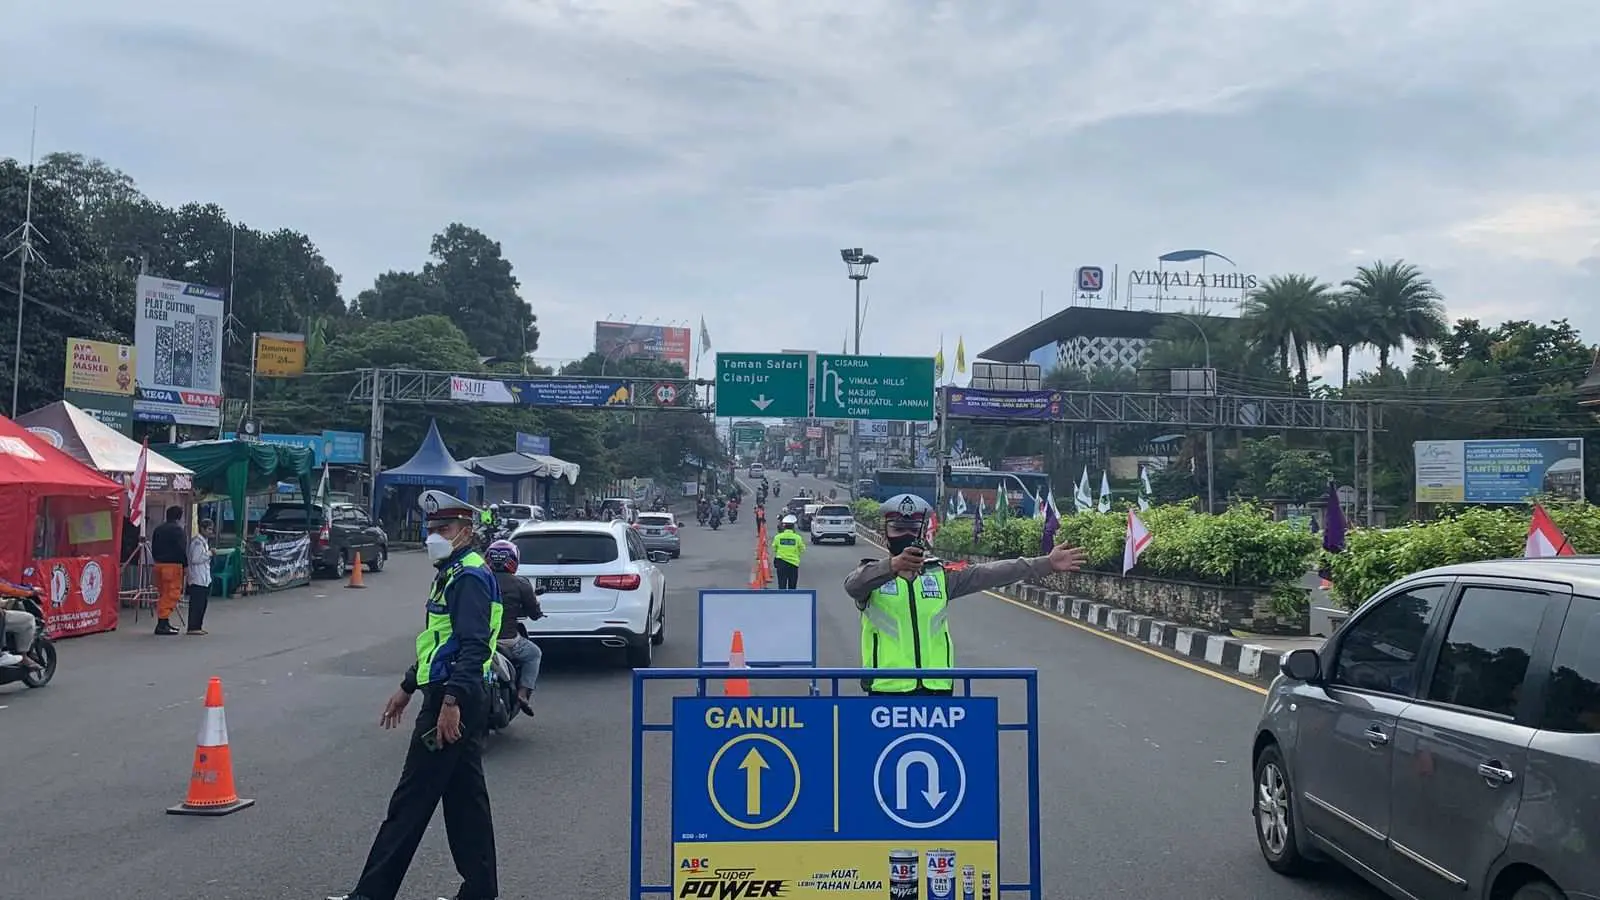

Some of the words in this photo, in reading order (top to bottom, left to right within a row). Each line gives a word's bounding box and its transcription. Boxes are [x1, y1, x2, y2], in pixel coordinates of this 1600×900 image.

[1213, 273, 1257, 289] HILLS
[145, 298, 163, 310] PLAT
[165, 300, 196, 315] CUTTING
[145, 309, 168, 321] LASER
[73, 352, 101, 363] PAKAI
[72, 362, 109, 373] MASKER
[723, 360, 762, 369] Taman
[766, 360, 803, 369] Safari
[834, 359, 869, 368] CISARUA
[722, 373, 770, 385] Cianjur
[848, 377, 878, 385] VIMALA
[882, 378, 905, 386] HILLS
[141, 390, 173, 400] MEGA
[848, 389, 877, 397] MASJID
[188, 395, 216, 405] BAJA
[848, 398, 893, 407] HARAKATUL
[898, 399, 929, 408] JANNAH
[848, 407, 870, 416] CIAWI
[1466, 464, 1501, 473] SANTRI
[1503, 464, 1531, 473] BARU
[705, 707, 804, 728] GANJIL
[871, 706, 966, 728] GENAP
[681, 858, 709, 868] ABC
[928, 857, 955, 868] ABC
[715, 868, 754, 881] Super
[831, 870, 858, 880] KUAT,
[891, 865, 916, 875] ABC
[680, 880, 784, 900] POWER
[816, 882, 850, 890] TAHAN
[853, 881, 882, 890] LAMA
